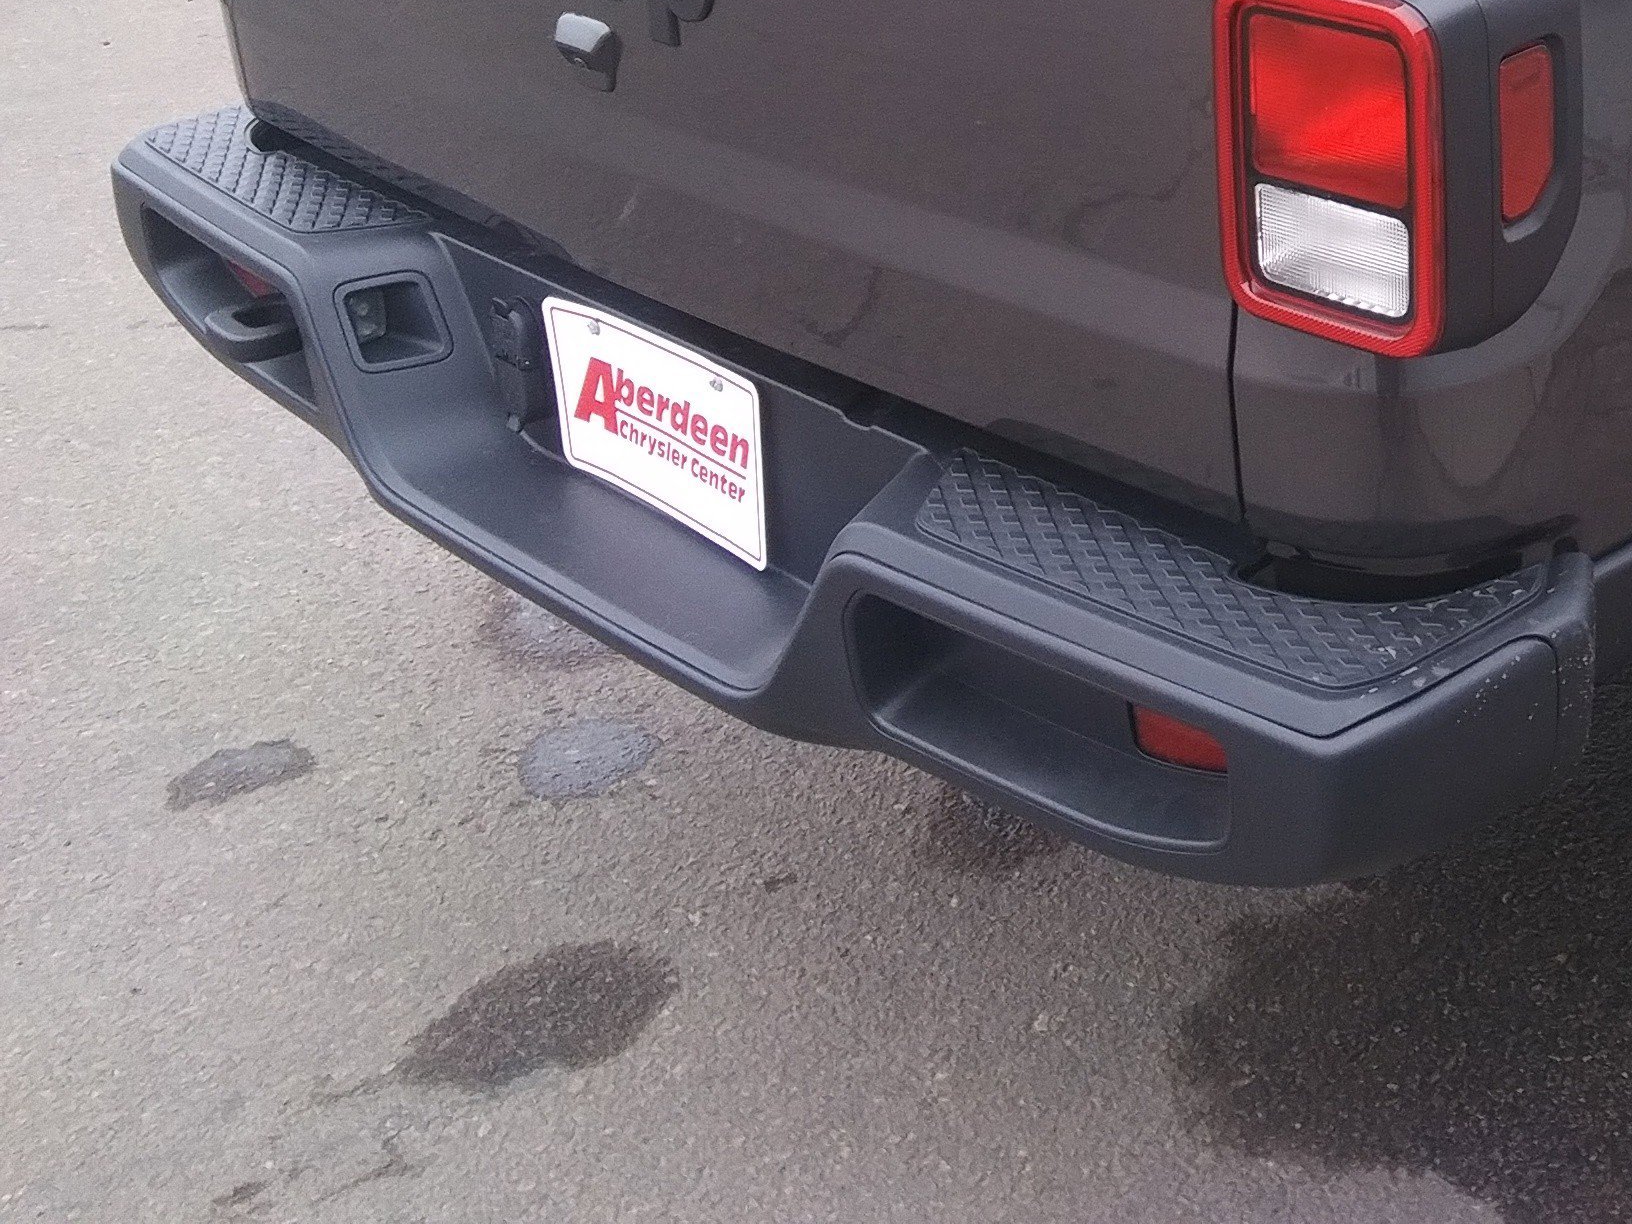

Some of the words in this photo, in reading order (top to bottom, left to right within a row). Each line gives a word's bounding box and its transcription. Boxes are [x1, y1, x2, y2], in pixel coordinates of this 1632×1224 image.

[574, 356, 750, 469] Aberdeen
[620, 418, 688, 470] Chrysler
[691, 458, 746, 503] Center
